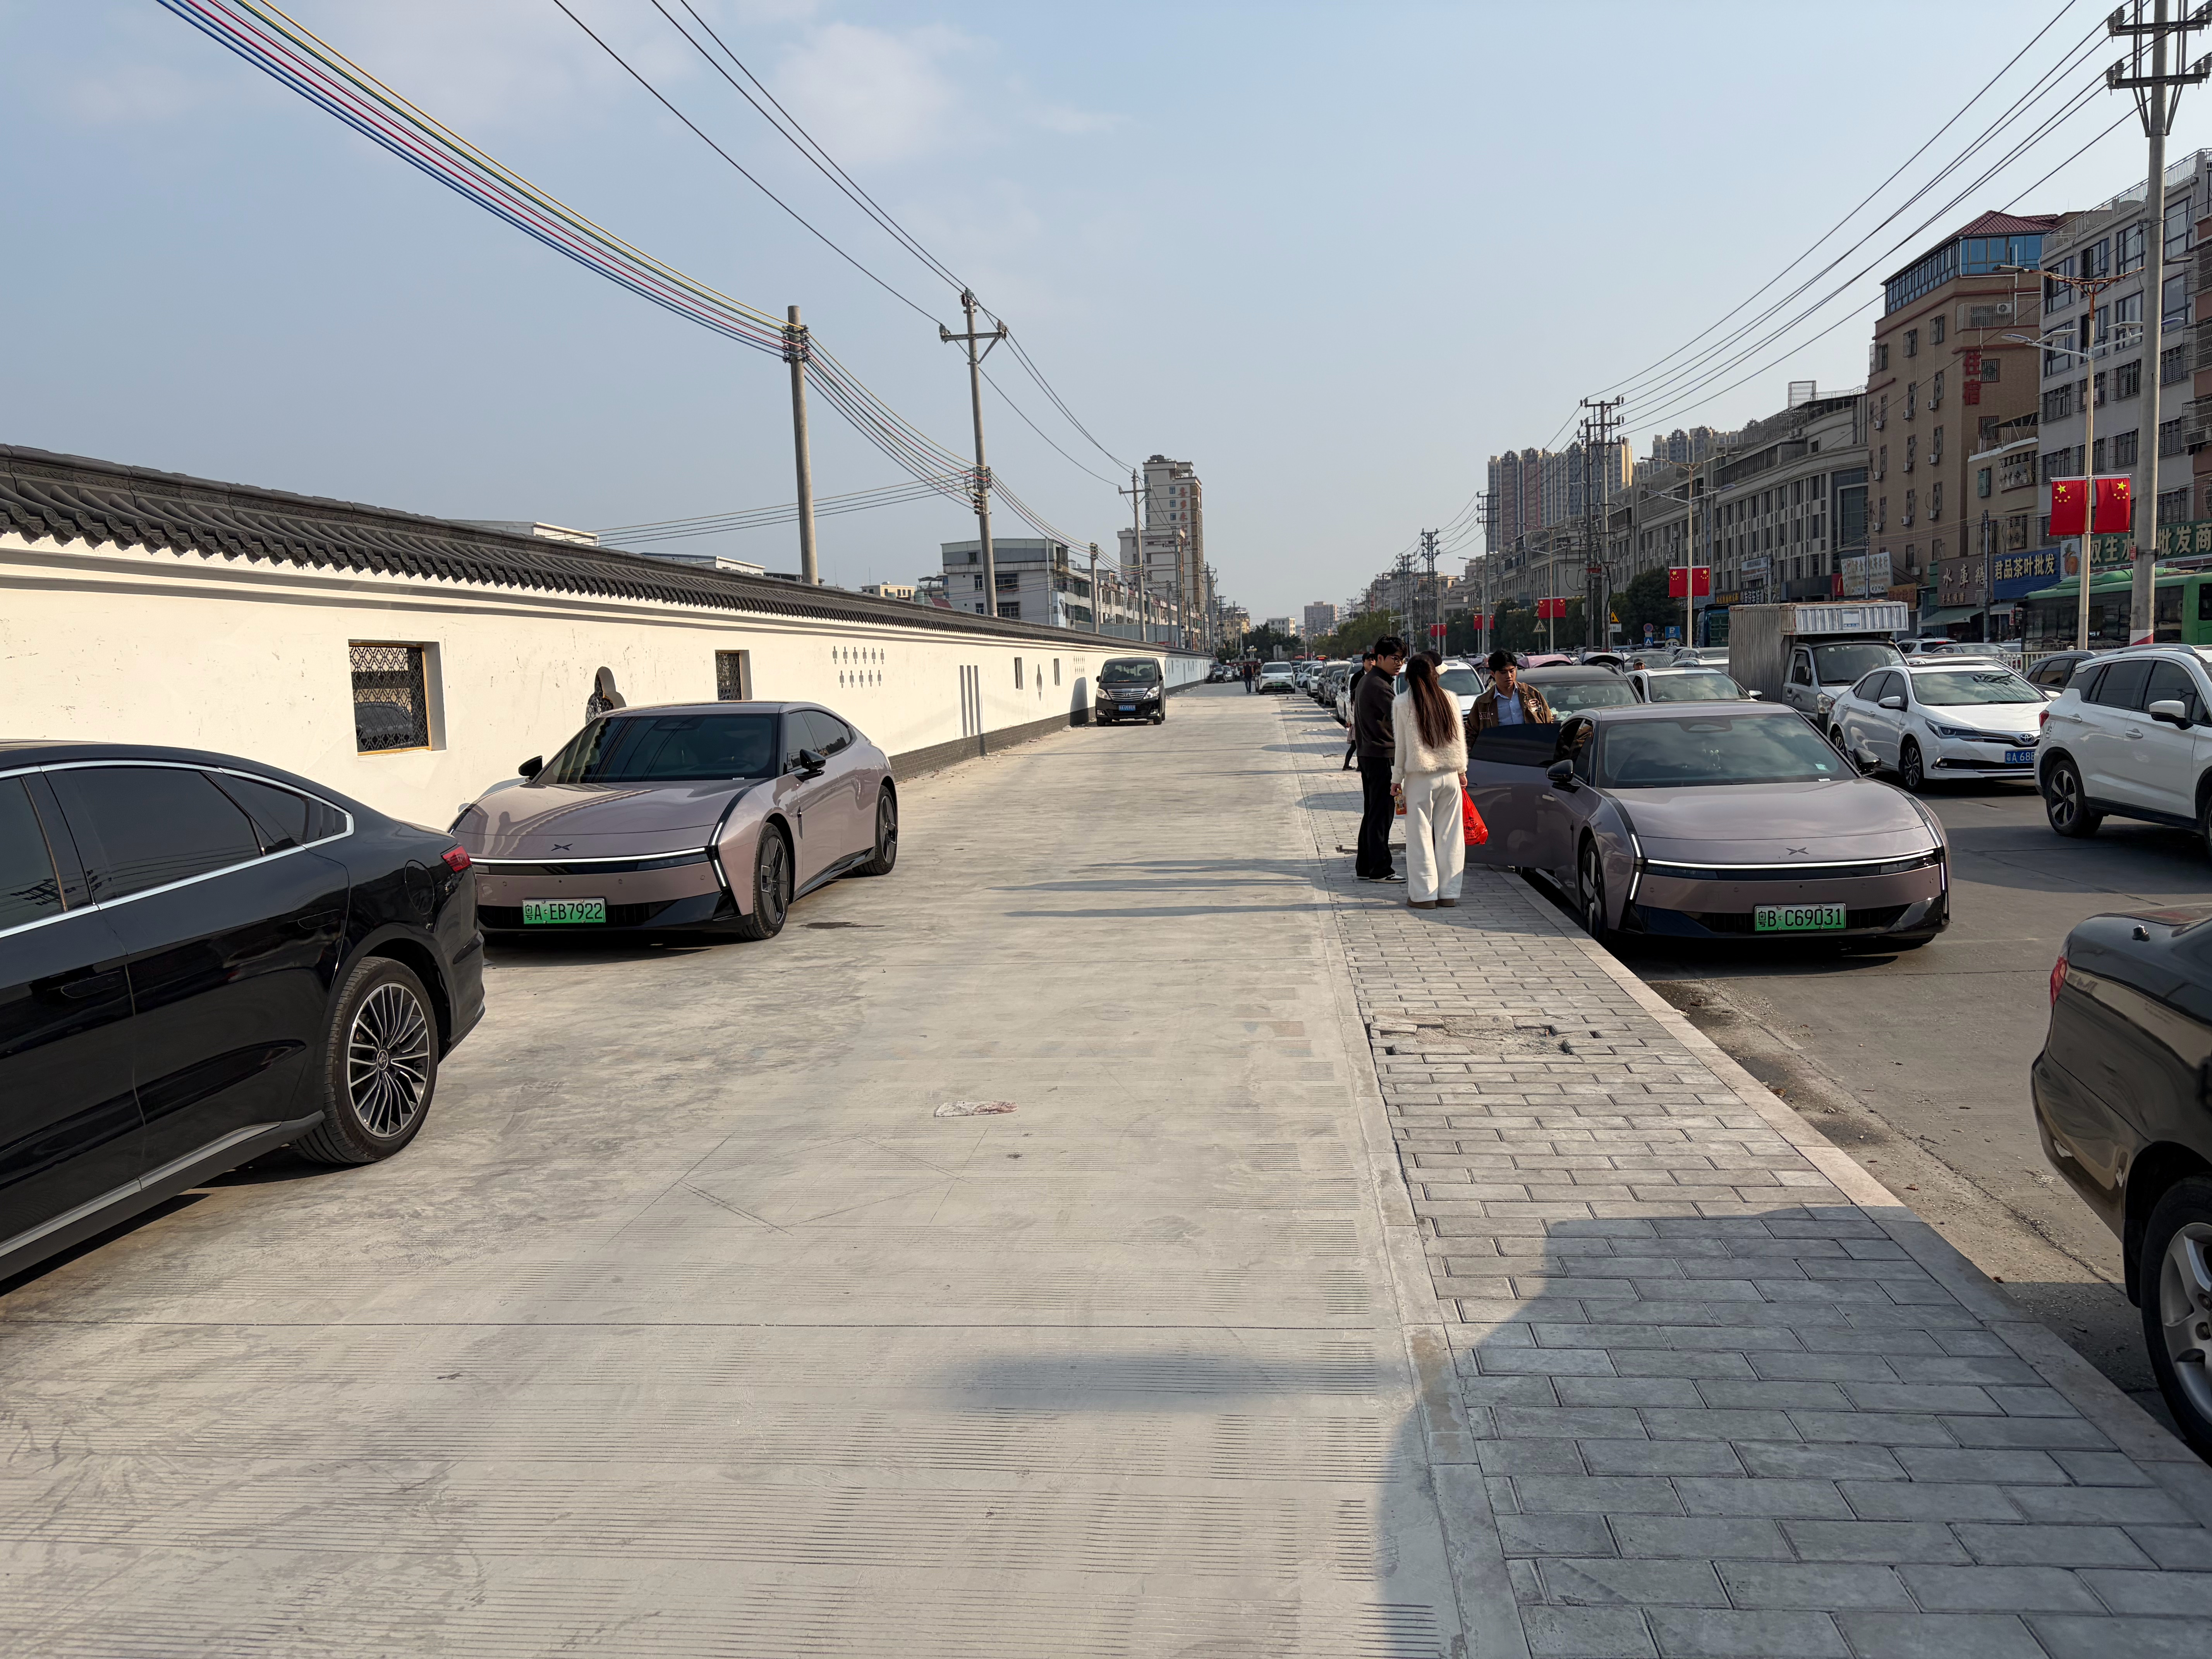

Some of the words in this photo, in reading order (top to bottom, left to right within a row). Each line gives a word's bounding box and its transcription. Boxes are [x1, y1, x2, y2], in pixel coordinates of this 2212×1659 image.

[1963, 350, 1981, 405] 住宿
[1994, 553, 2055, 581] 君品茶叶批发
